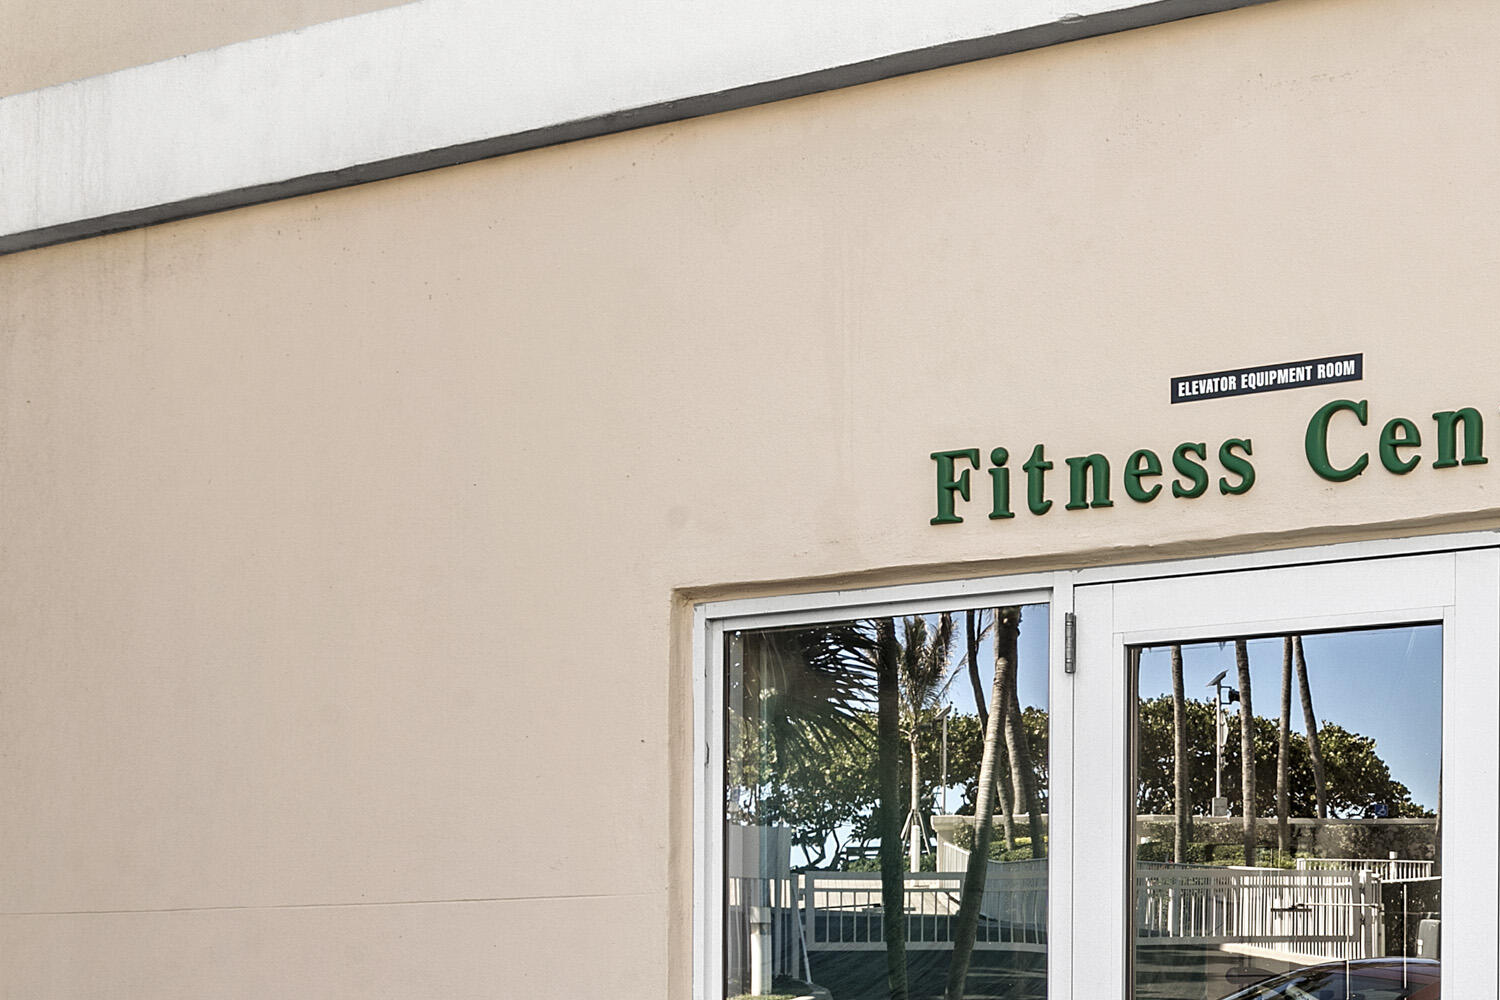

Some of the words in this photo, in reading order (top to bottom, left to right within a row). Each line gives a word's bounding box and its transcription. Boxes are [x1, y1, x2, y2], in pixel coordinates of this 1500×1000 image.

[1178, 376, 1237, 397] ELEVATOR
[1241, 366, 1313, 389] EQUIPMENT
[1317, 360, 1355, 379] ROOM
[930, 438, 1256, 525] Fitness
